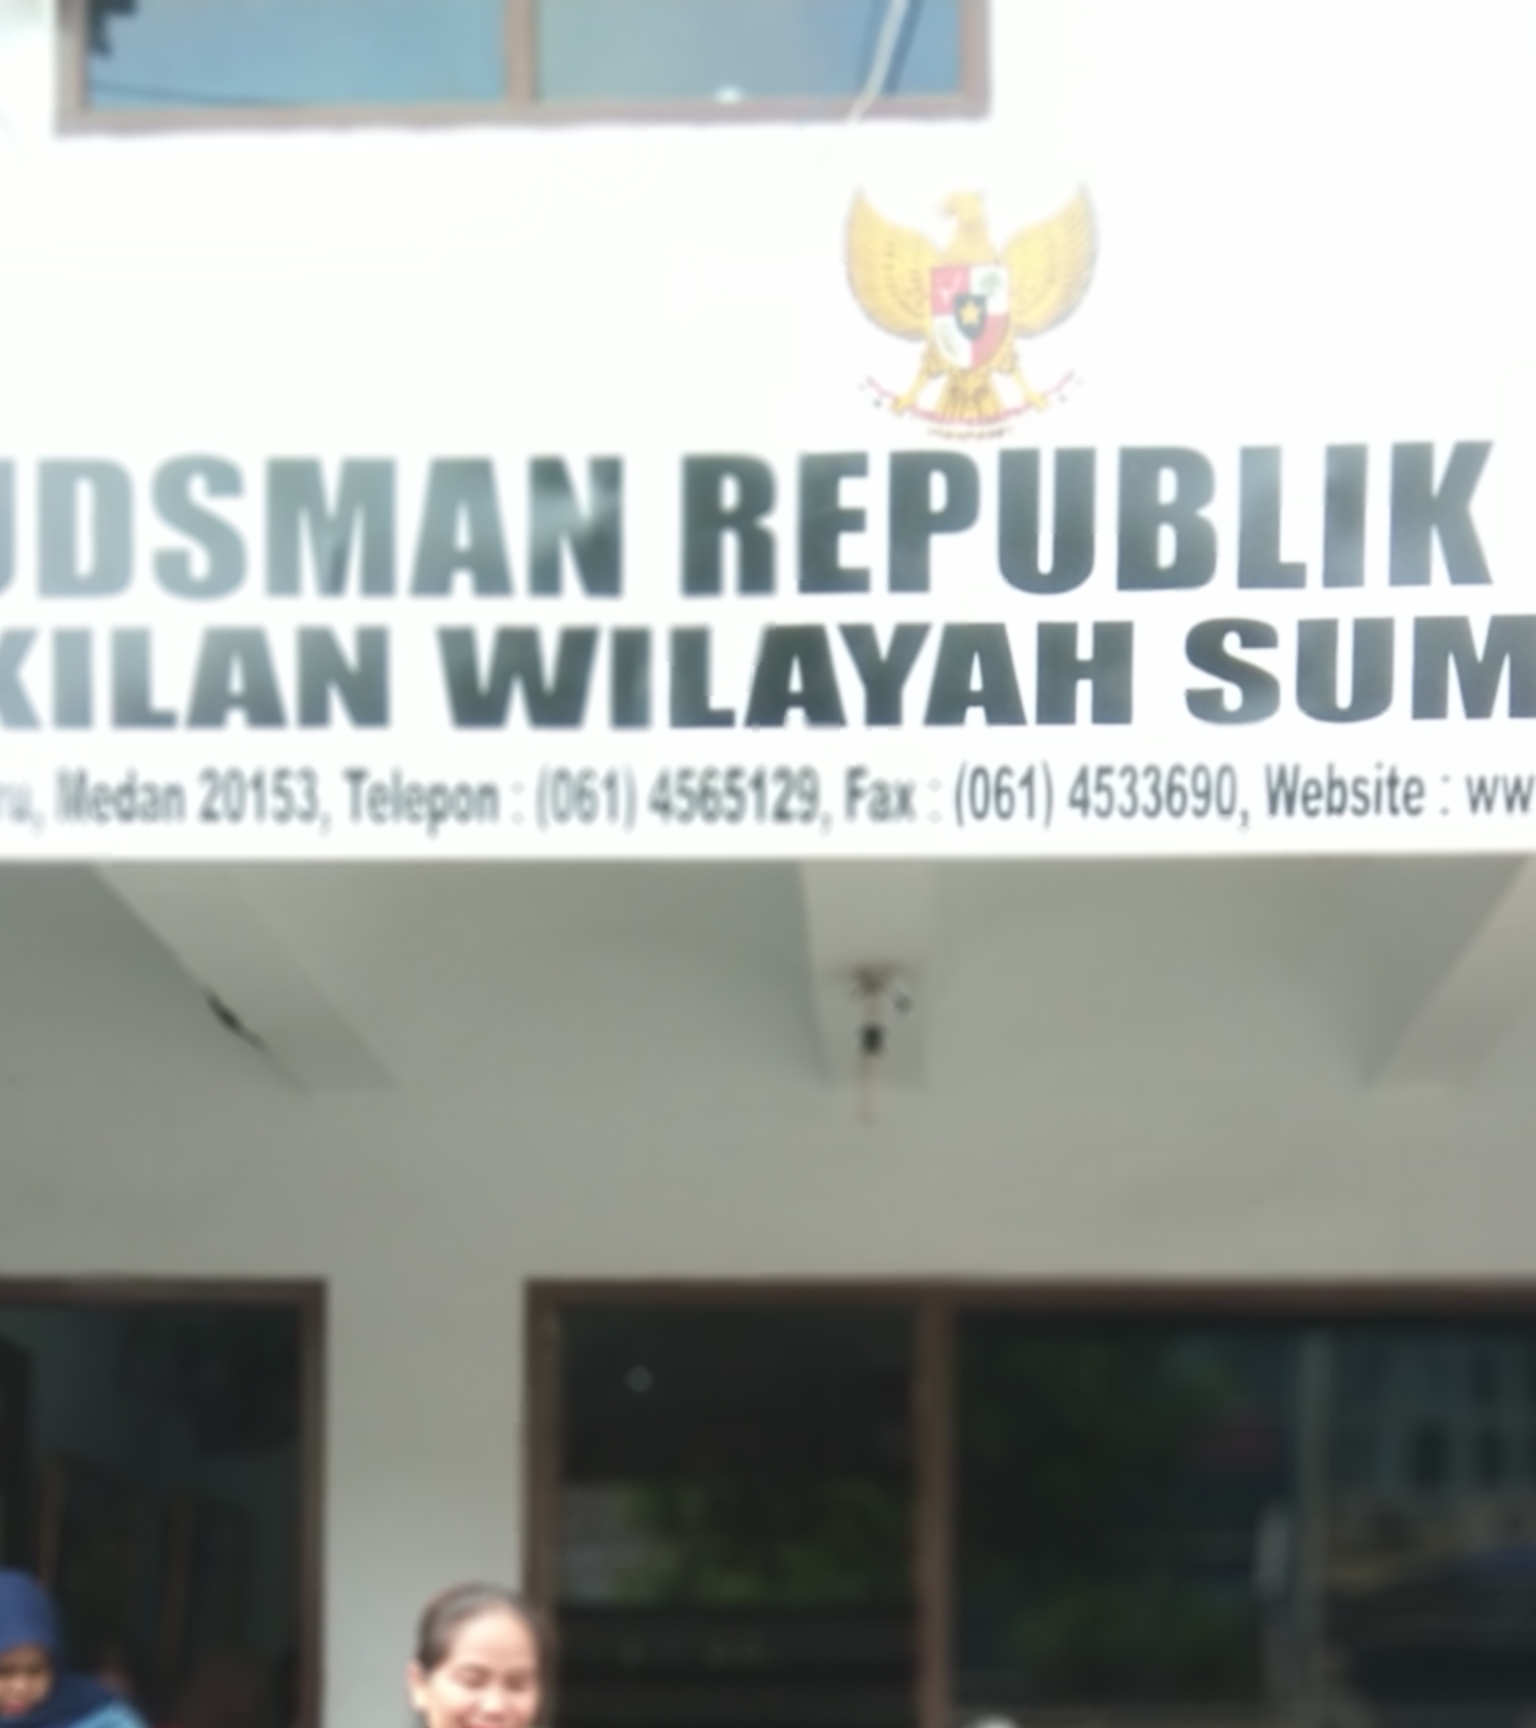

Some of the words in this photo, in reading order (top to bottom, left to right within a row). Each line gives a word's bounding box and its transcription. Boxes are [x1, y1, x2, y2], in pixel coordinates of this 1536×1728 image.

[679, 440, 1495, 598] REPUBLIK
[435, 618, 1135, 729] WILAYAH
[55, 767, 187, 825] Medan
[197, 766, 335, 836] 20153,
[342, 766, 501, 838] Telepon
[533, 764, 640, 832] (061)
[647, 764, 837, 834] 4565129,
[843, 763, 918, 824] Fax
[951, 760, 1056, 828] (061)
[1067, 762, 1251, 830] 4533690,
[1264, 761, 1427, 820] Website
